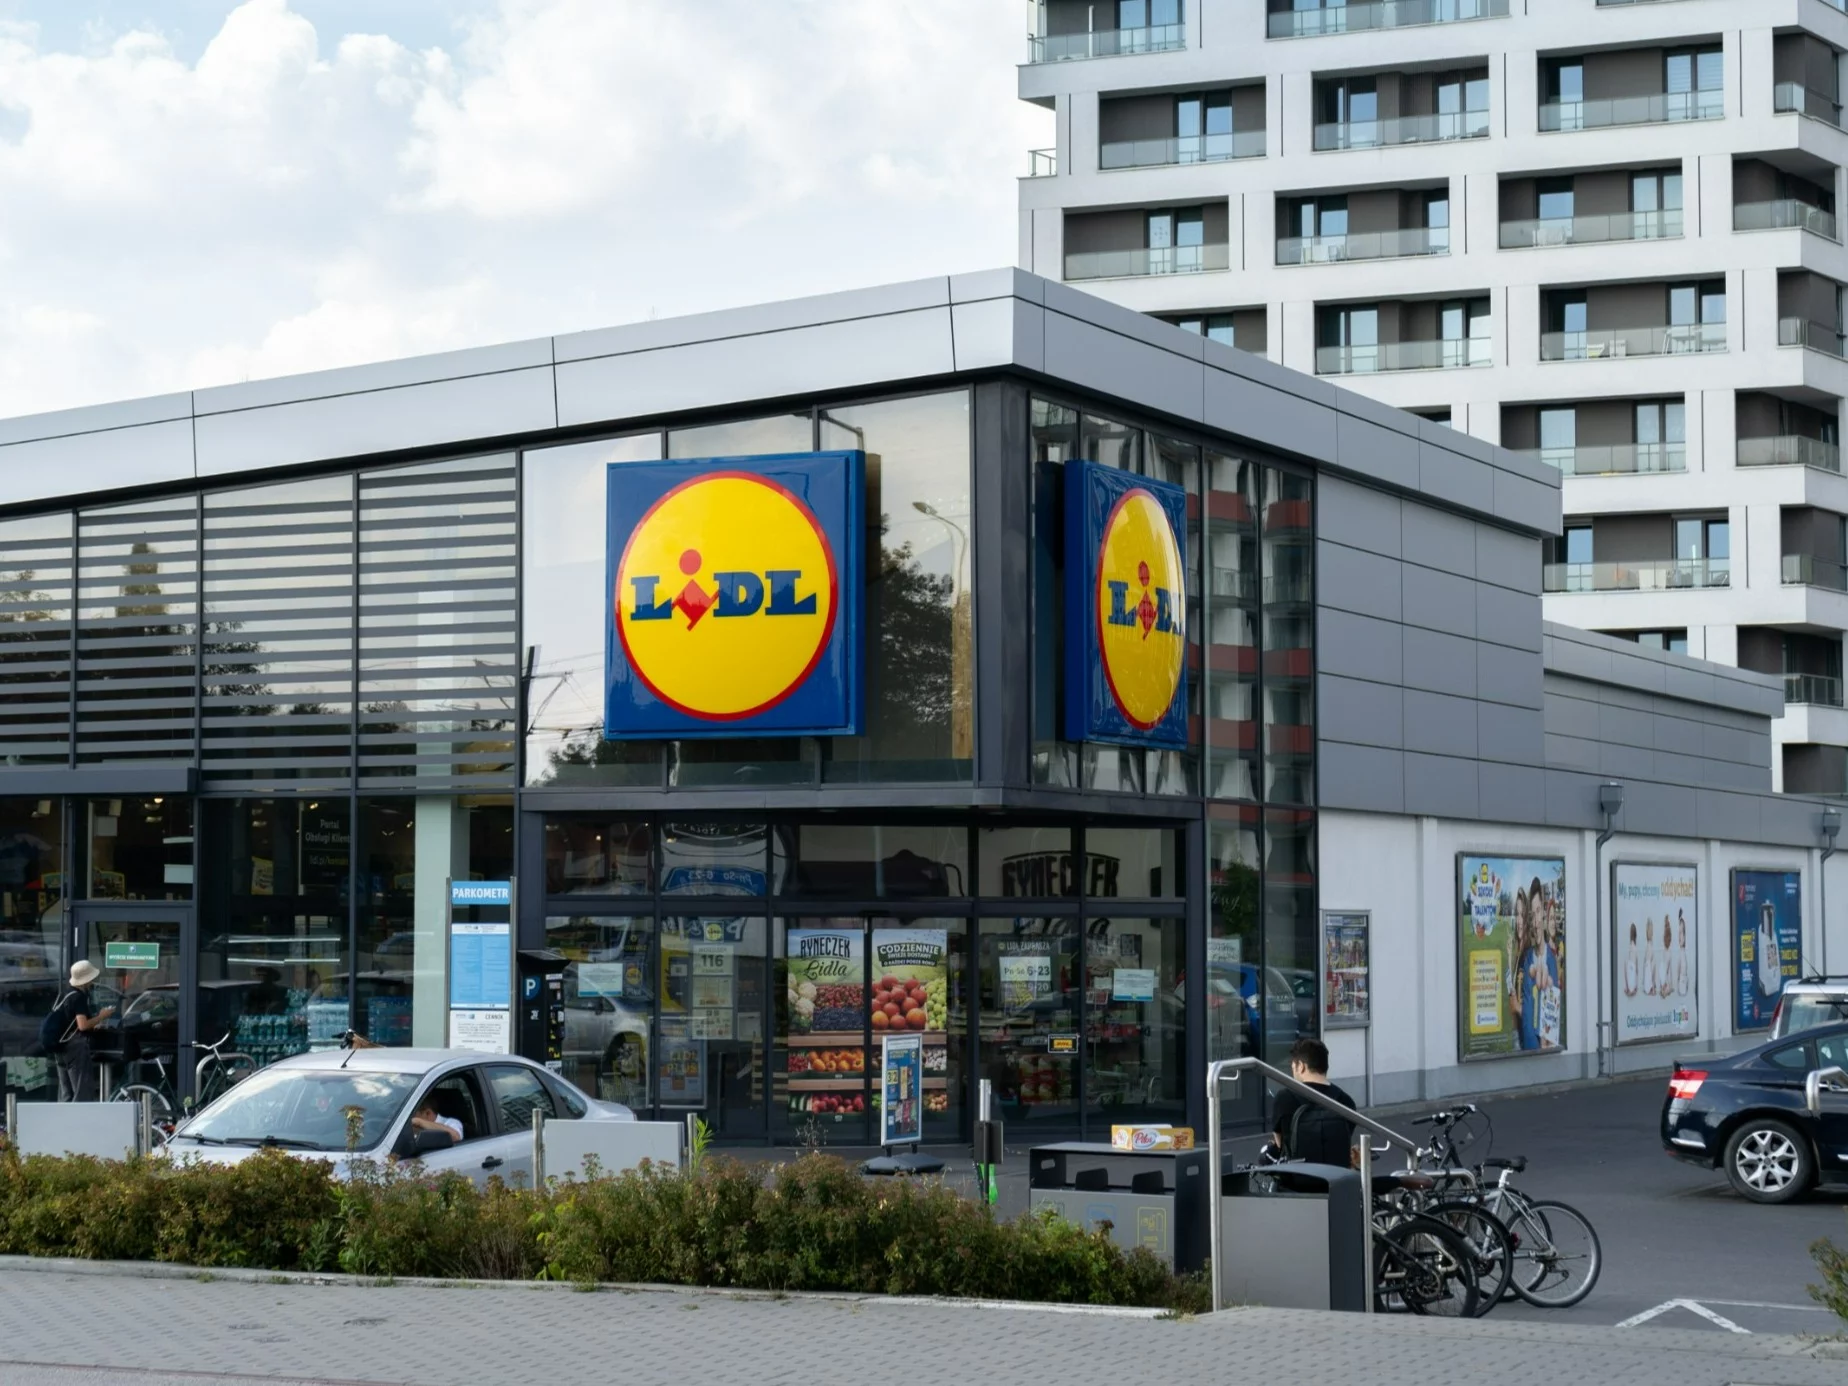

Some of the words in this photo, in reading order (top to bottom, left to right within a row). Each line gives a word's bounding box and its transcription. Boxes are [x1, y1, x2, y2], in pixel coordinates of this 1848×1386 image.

[452, 887, 509, 899] PARKOMETR
[800, 936, 850, 958] RYNECZEK
[880, 943, 939, 955] CODZIENNIE
[701, 954, 724, 967] 116
[803, 959, 847, 980] Lidla
[1027, 966, 1050, 976] 6-23
[526, 978, 536, 996] P
